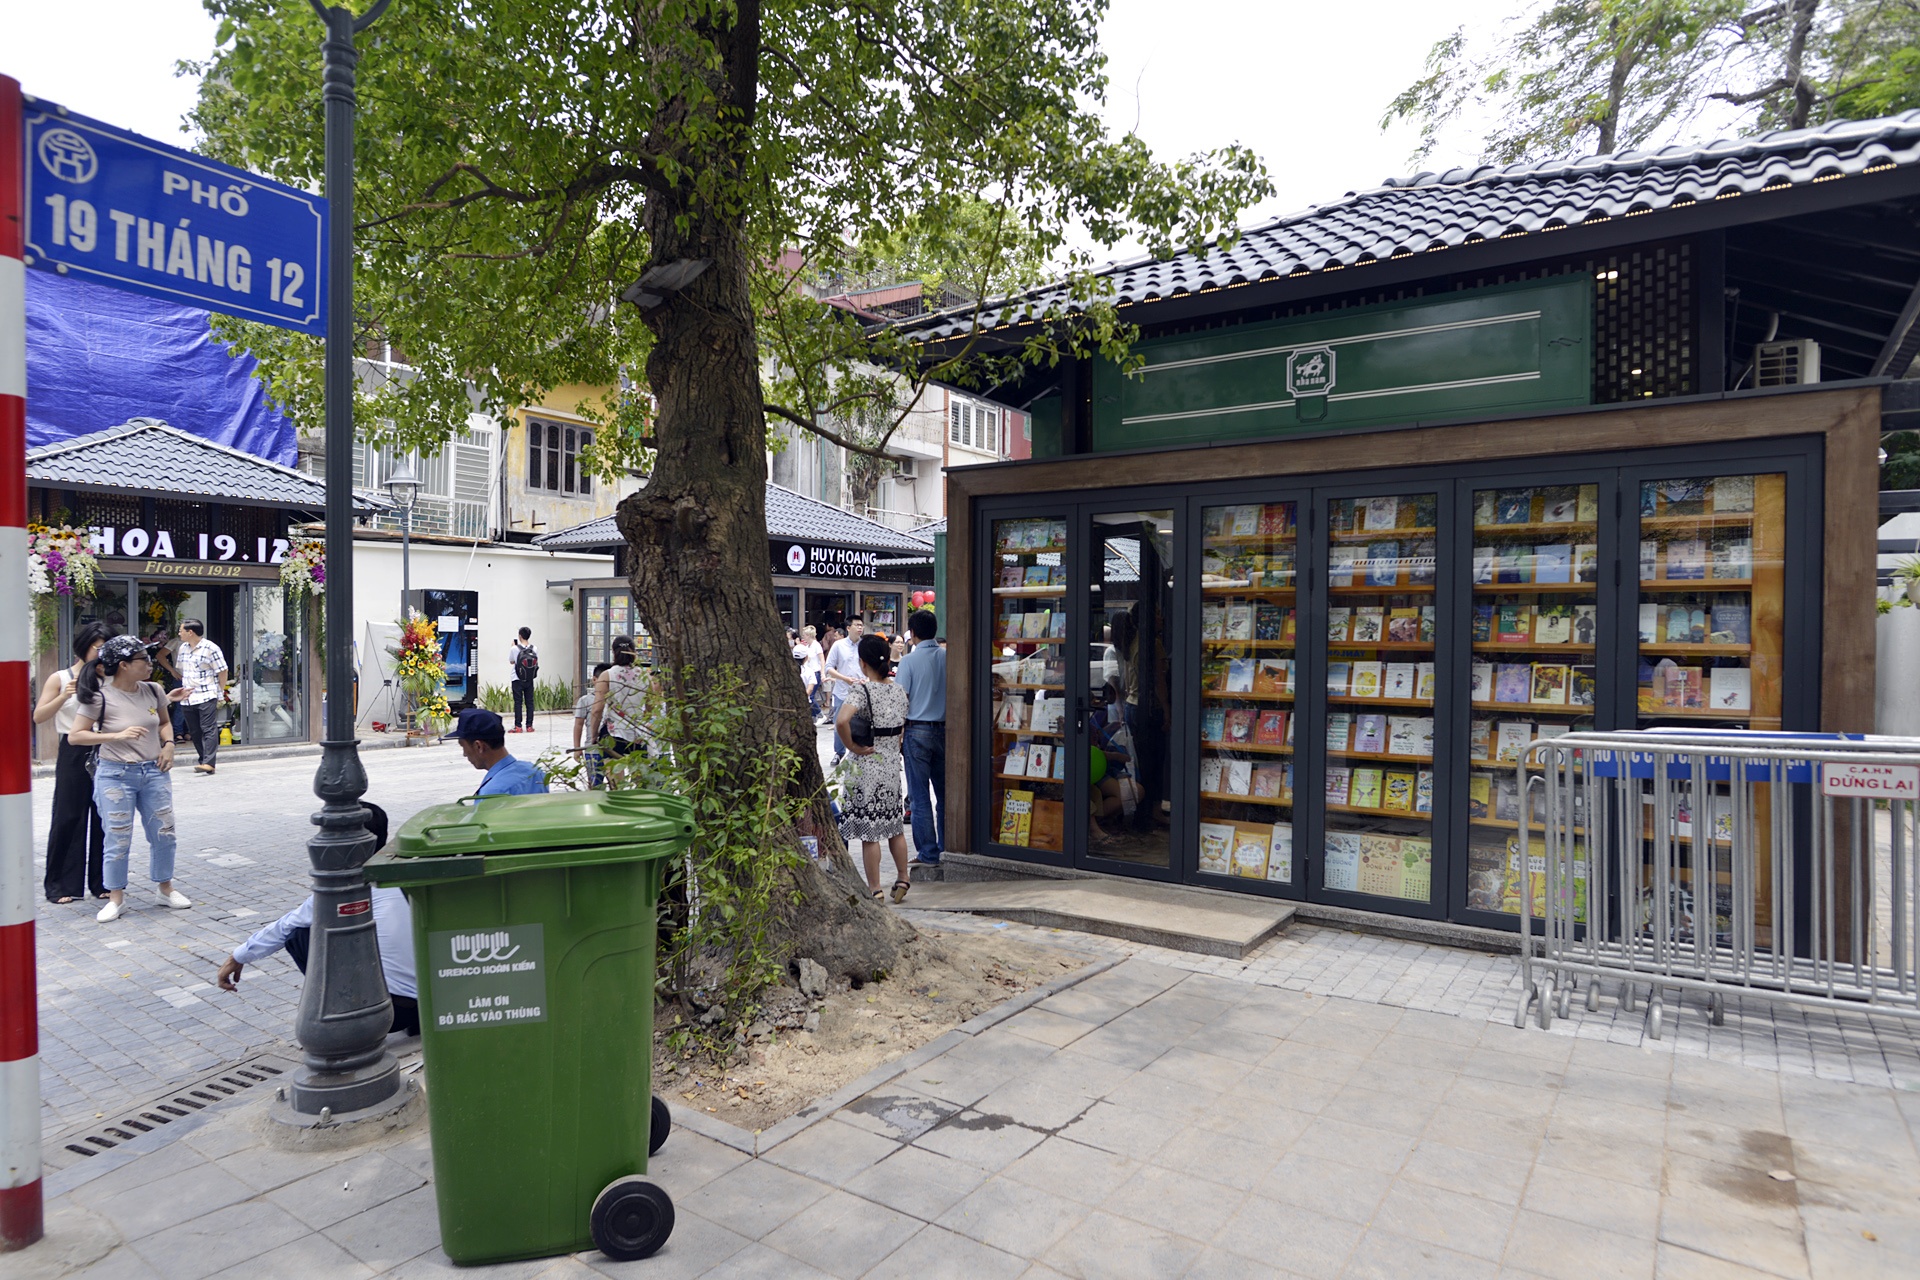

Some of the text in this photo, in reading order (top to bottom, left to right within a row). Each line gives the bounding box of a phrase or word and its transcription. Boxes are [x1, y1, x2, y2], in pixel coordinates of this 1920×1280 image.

[163, 170, 252, 217] PHỐ
[45, 193, 305, 308] 19 THÁNG 12
[88, 526, 290, 563] HOA 19.12
[143, 561, 242, 577] Florist 19.12
[811, 562, 877, 578] BOOKSTORE
[1849, 766, 1893, 775] C.A.H.N
[1829, 774, 1914, 792] DỪNG LẠI
[438, 967, 481, 978] URENCO
[512, 959, 536, 972] KIẾM
[468, 995, 510, 1008] LÀM ƠN
[438, 1006, 541, 1025] BỎ RÁC VÀO THÙNG
